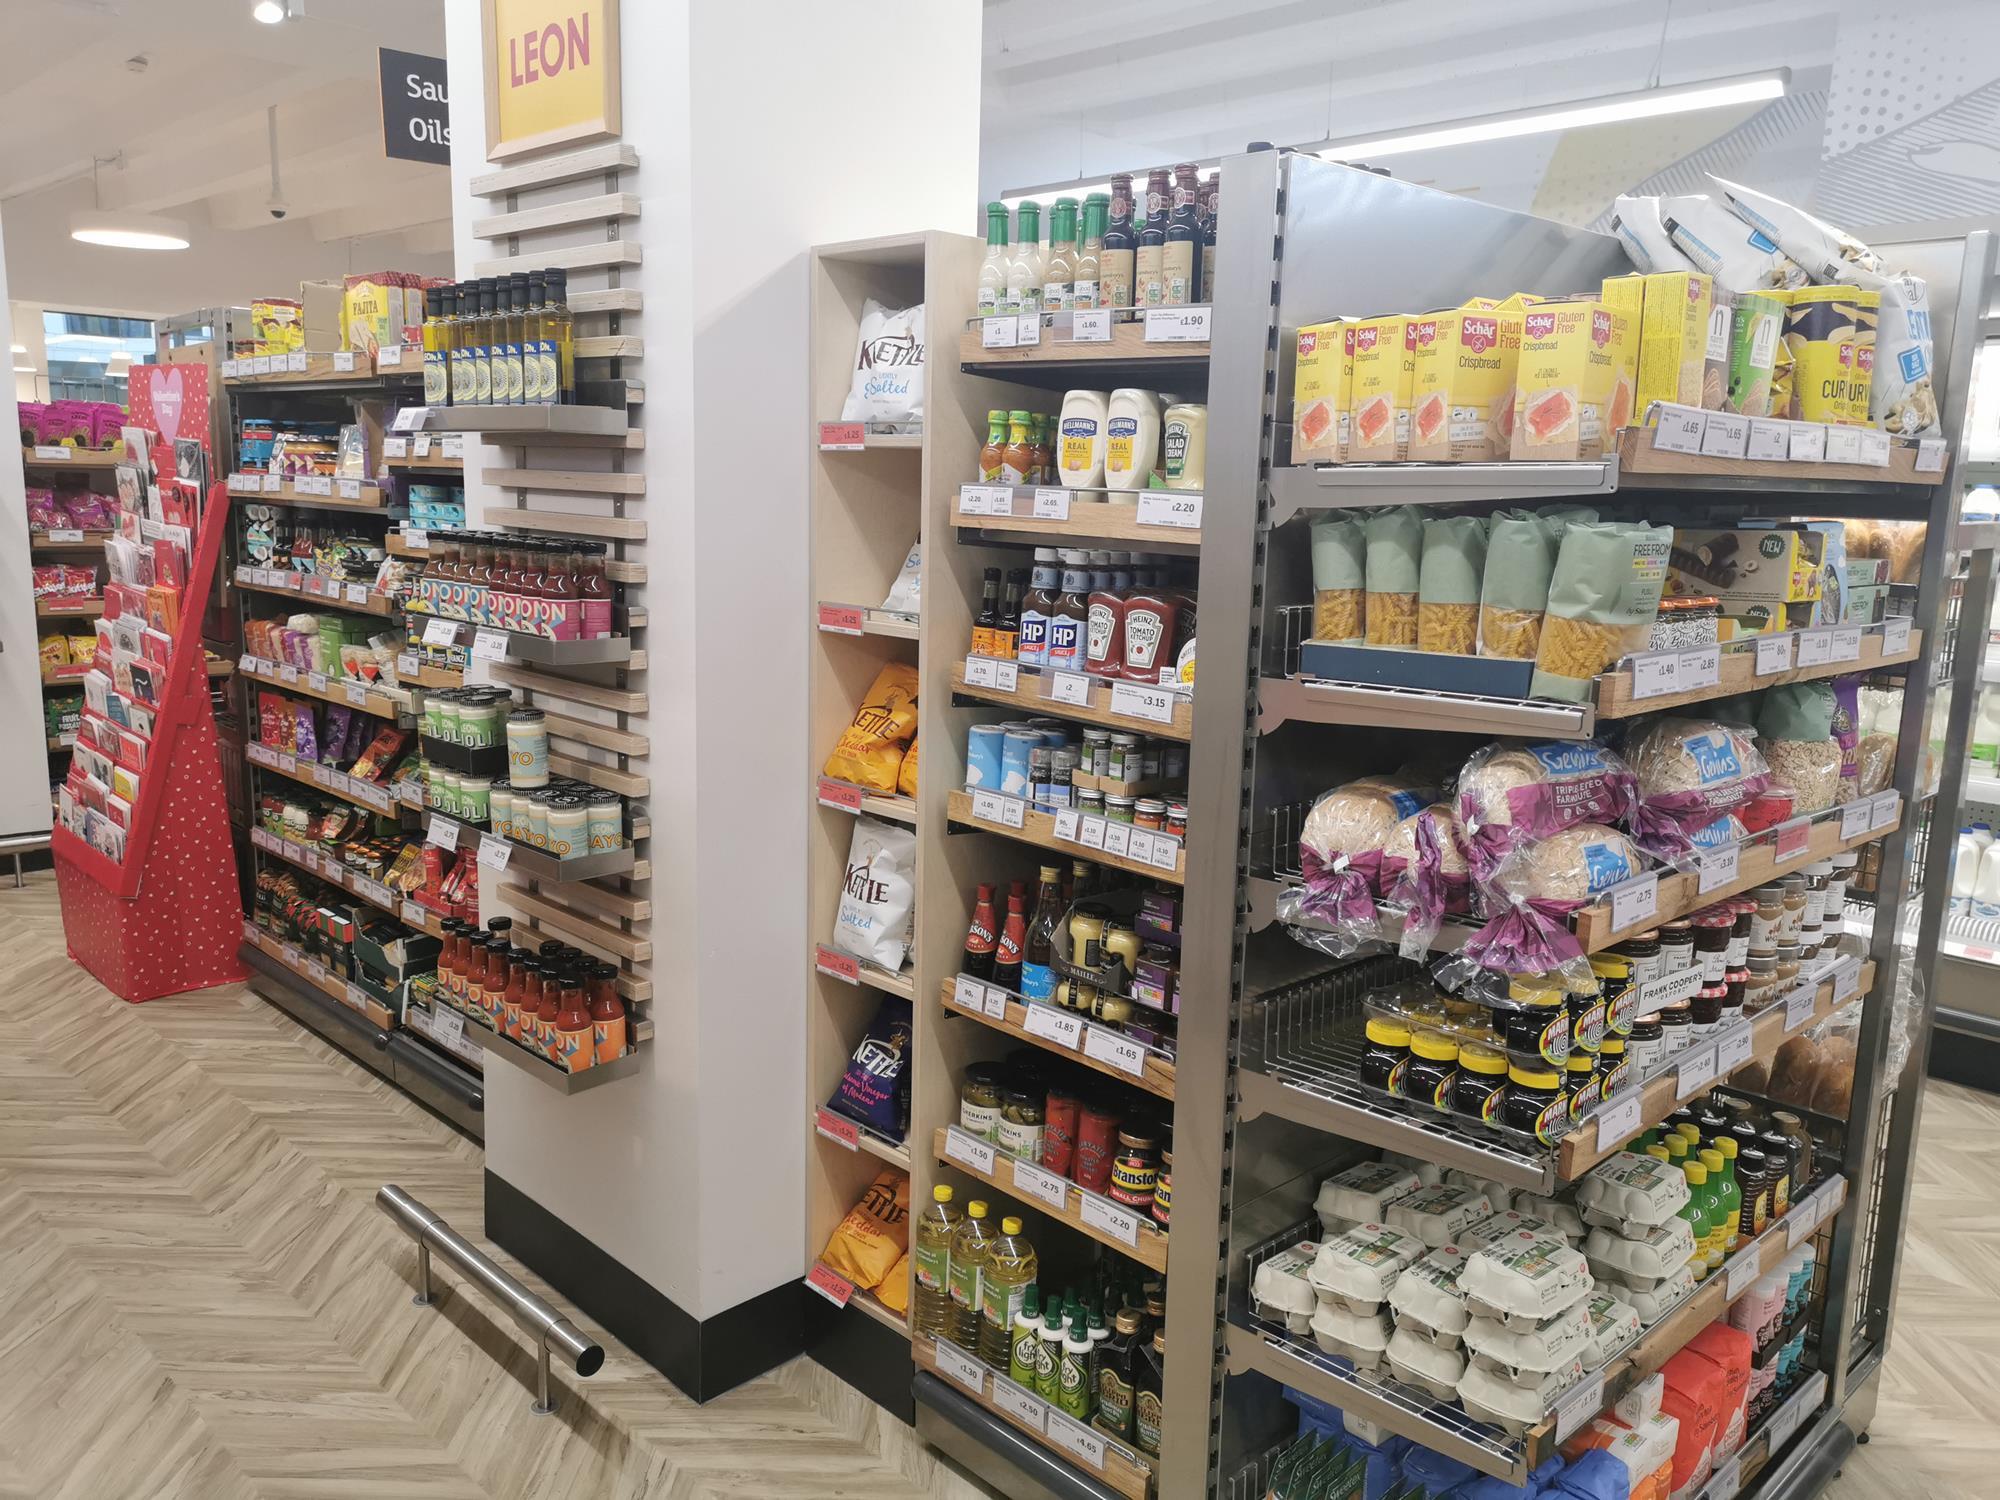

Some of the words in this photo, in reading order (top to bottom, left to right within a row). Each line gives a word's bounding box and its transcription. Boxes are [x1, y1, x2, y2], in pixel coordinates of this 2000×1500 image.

[509, 12, 590, 88] LEON
[353, 300, 378, 316] FAJITA
[1180, 316, 1203, 326] £1.90
[1527, 315, 1553, 328] Schär
[1557, 312, 1584, 324] Gluten
[1379, 325, 1399, 335] Gluten
[1463, 321, 1496, 338] Schär
[1557, 323, 1575, 334] Free
[1378, 336, 1392, 345] Free
[1437, 331, 1448, 341] Free
[1500, 335, 1521, 349] Free
[1523, 341, 1558, 351] Crispbread
[1459, 355, 1501, 370] Crispbread
[1822, 379, 1848, 399] CUR
[1682, 421, 1698, 434] £1.65
[1727, 428, 1742, 440] £1.65
[1067, 442, 1087, 450] REAL
[1111, 442, 1127, 450] REAL
[1172, 503, 1195, 513] £2.20
[1762, 540, 1782, 554] NEW
[1132, 615, 1152, 626] HEINZ
[1022, 621, 1044, 640] HP
[1052, 628, 1073, 647] HP
[1130, 626, 1155, 637] TOMATO
[1658, 663, 1675, 677] £1.40
[1700, 658, 1715, 672] £2.85
[1144, 696, 1165, 708] £3.15
[1637, 888, 1652, 904] £2.75
[1070, 967, 1095, 981] MAILLE
[1643, 984, 1668, 1000] FRANK
[1669, 971, 1702, 991] COOPER'S
[1055, 1020, 1075, 1033] £1.85
[1116, 1046, 1137, 1060] £1.65
[963, 1107, 992, 1121] GHERKINS
[1625, 1105, 1633, 1120] £3
[971, 1147, 988, 1160] £1.50
[1040, 1180, 1059, 1194] £2.75
[1110, 1216, 1130, 1230] £2.20
[1023, 1341, 1036, 1351] fry
[960, 1364, 977, 1379] £1.30
[1019, 1401, 1038, 1417] £2.50
[1076, 1437, 1097, 1454] £4.65
